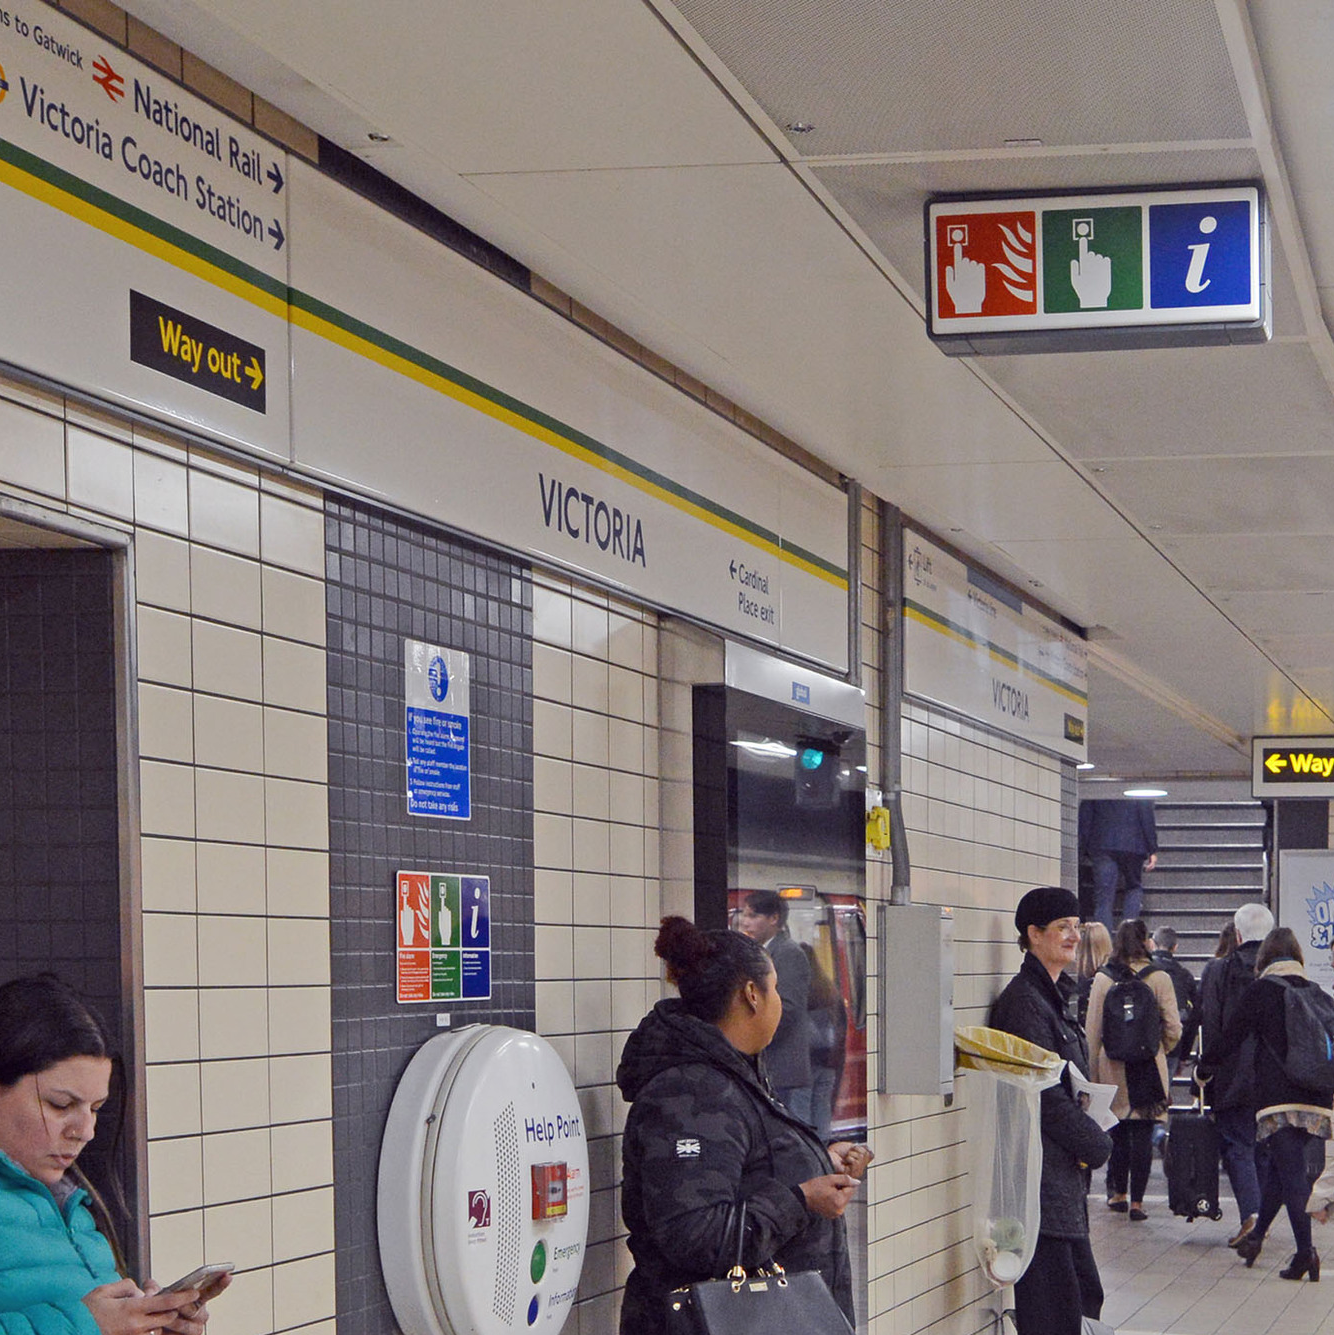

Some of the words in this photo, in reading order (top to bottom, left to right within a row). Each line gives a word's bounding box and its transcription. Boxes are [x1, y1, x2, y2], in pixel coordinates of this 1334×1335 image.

[15, 15, 29, 38] to
[33, 25, 83, 70] Gatwick
[133, 79, 222, 162] National
[229, 136, 263, 186] Rail
[20, 76, 113, 160] Victoria
[121, 136, 188, 200] Coach
[195, 176, 263, 242] Station
[158, 316, 203, 374] Way
[207, 347, 241, 384] out
[539, 472, 646, 568] VICTORIA
[739, 564, 769, 595] Cardinal
[739, 592, 759, 618] Place
[760, 604, 774, 625] exit
[992, 678, 1029, 722] VICTORIA
[1289, 754, 1334, 778] Way
[525, 1116, 555, 1146] Help
[557, 1114, 581, 1140] Point
[553, 1242, 581, 1261] Emergency
